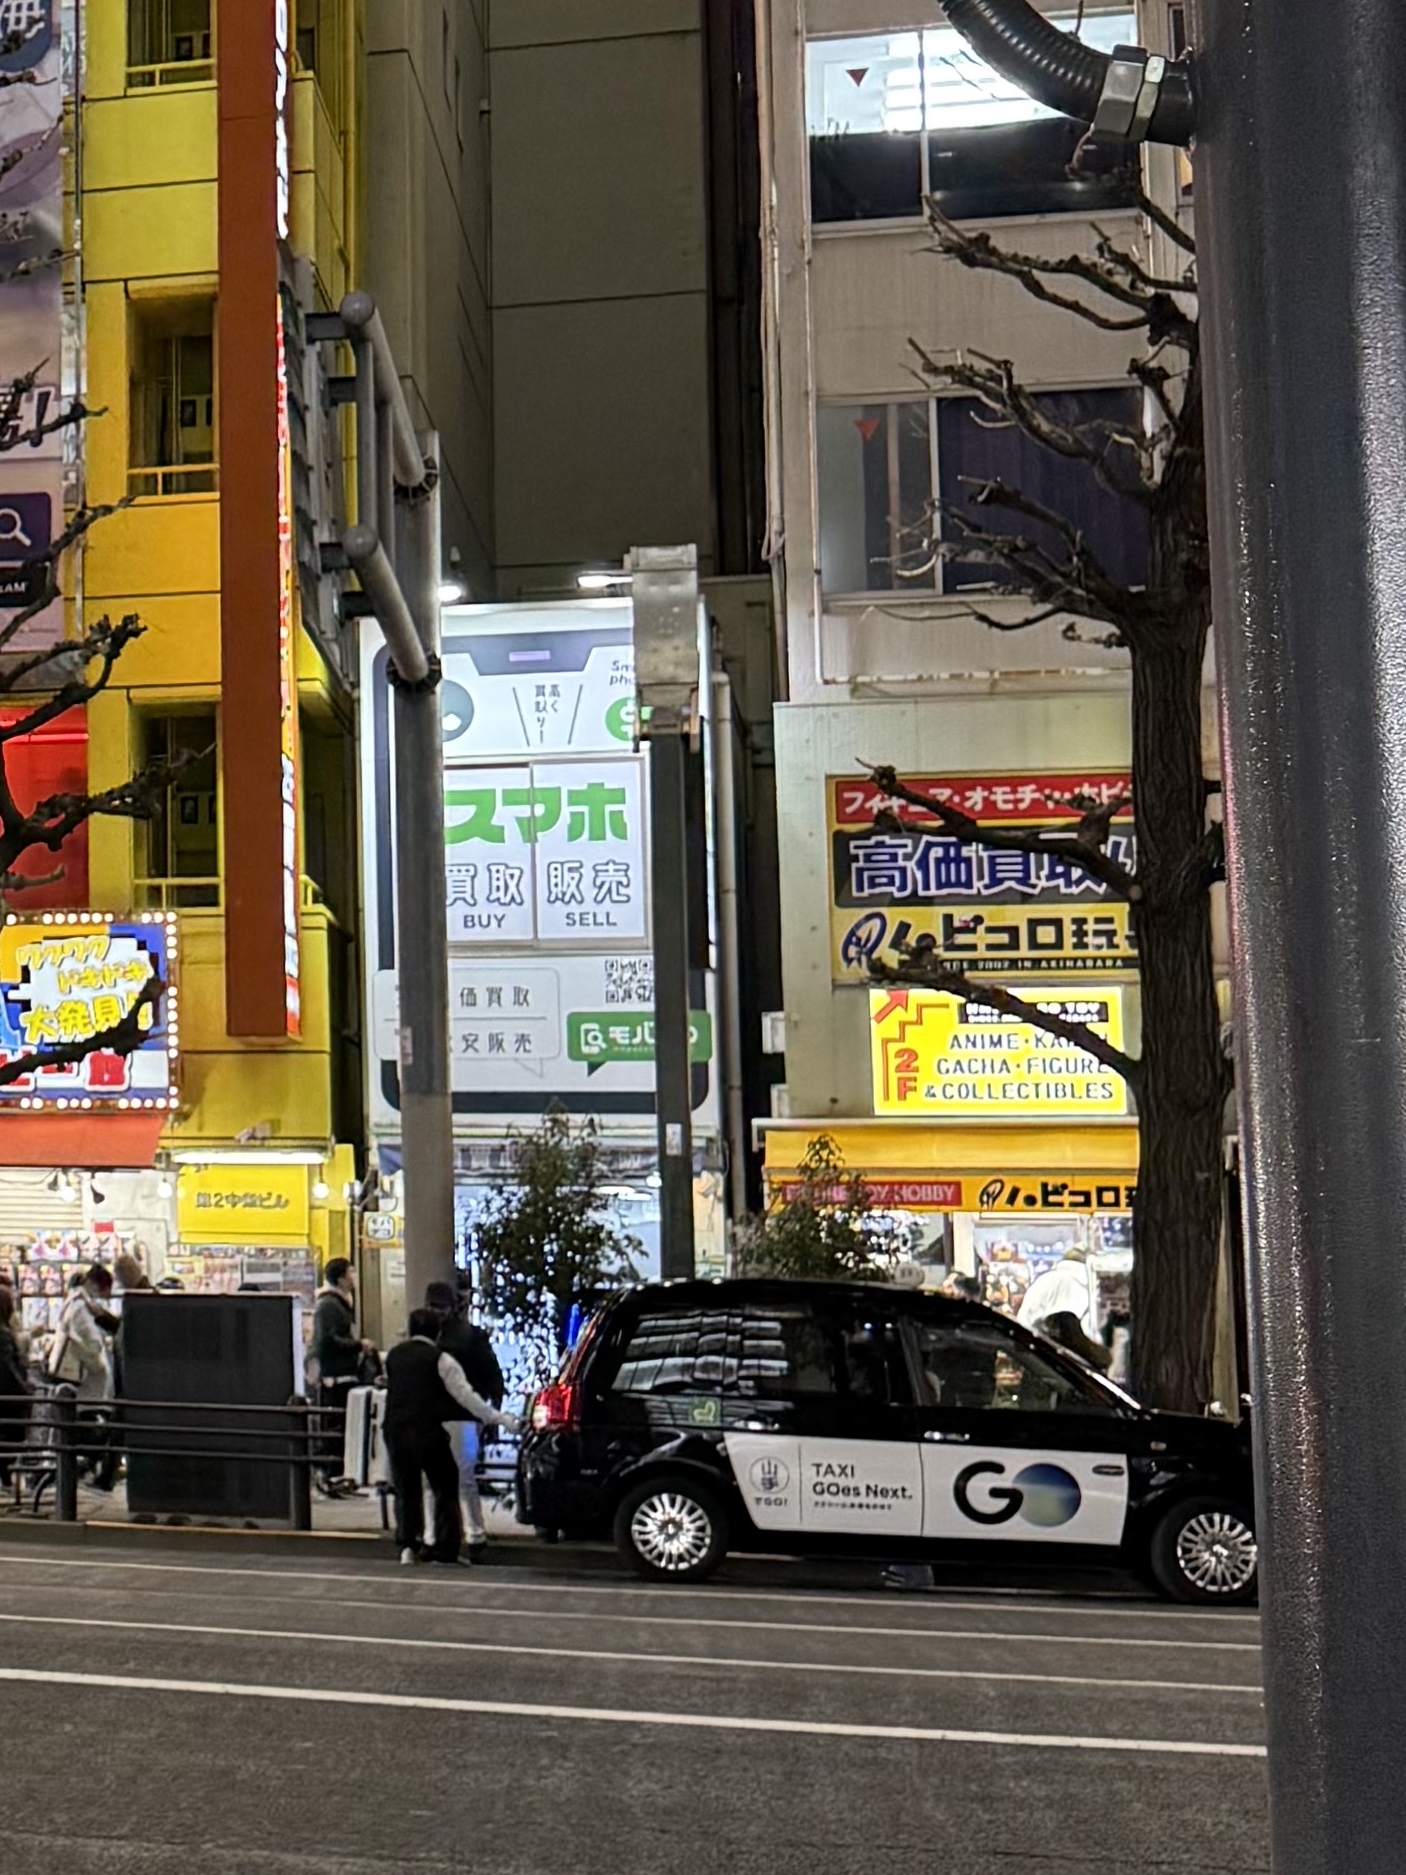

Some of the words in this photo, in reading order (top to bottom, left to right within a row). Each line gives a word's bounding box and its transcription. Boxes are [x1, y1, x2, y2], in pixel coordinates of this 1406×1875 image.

[444, 782, 629, 845] スマホ
[445, 862, 524, 908] 買取
[546, 859, 631, 906] 販売
[462, 913, 507, 929] BUY
[564, 911, 618, 927] SELL
[811, 1463, 855, 1479] TAXI
[865, 1482, 913, 1500] Next.
